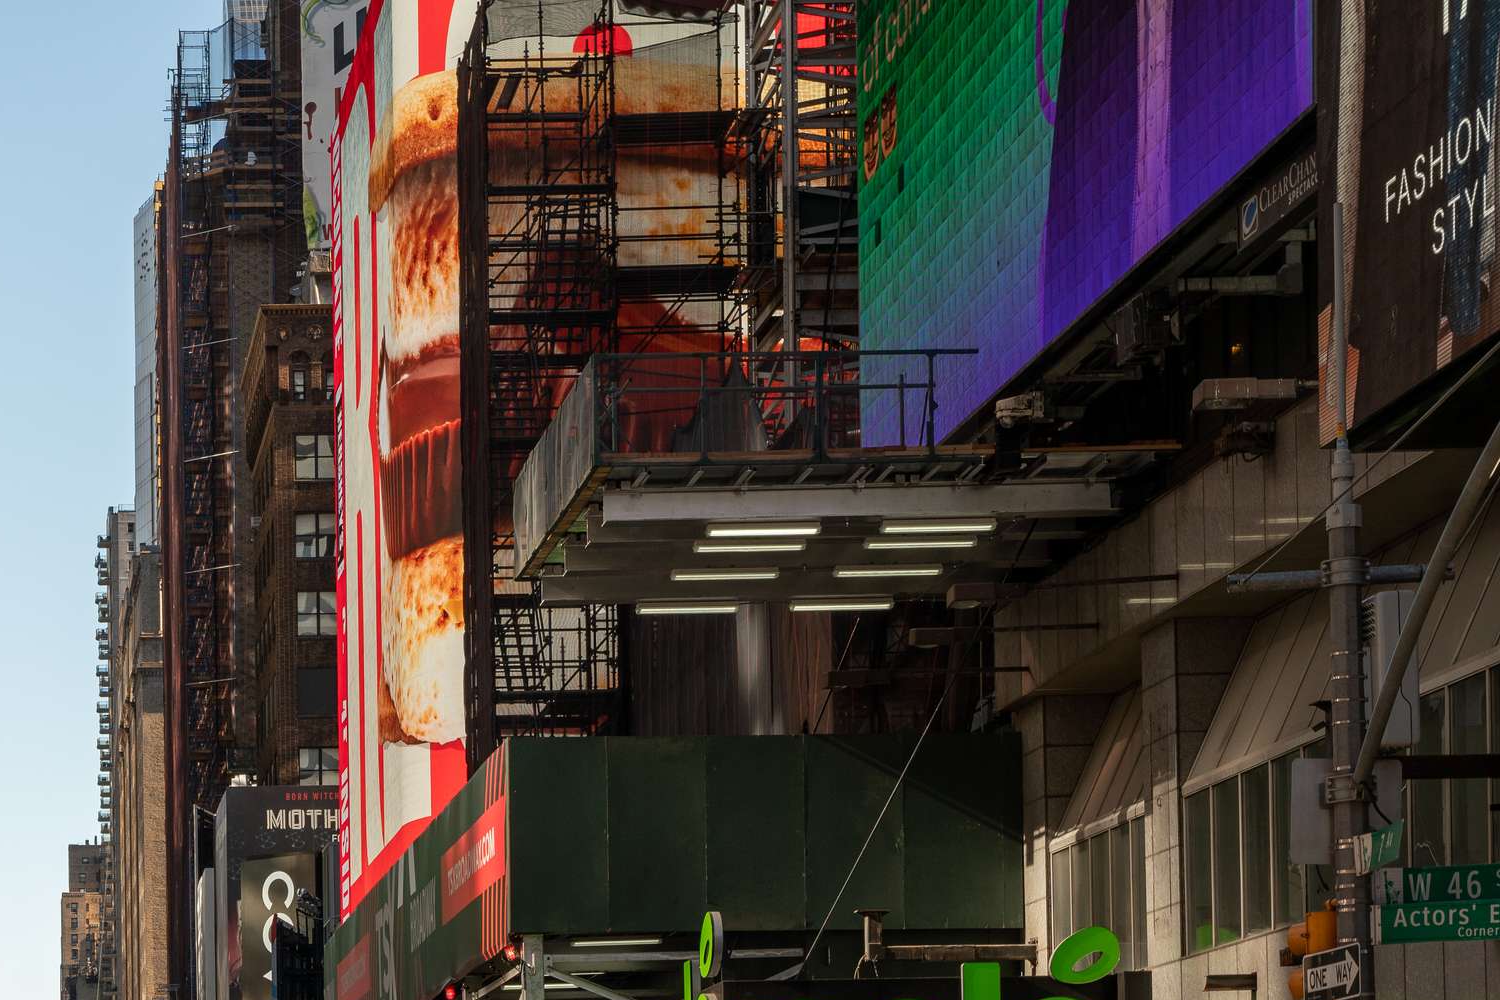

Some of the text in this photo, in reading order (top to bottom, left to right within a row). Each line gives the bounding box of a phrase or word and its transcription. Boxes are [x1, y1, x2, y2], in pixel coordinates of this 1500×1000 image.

[1384, 98, 1492, 224] FASHION
[1432, 173, 1496, 255] STYL
[285, 791, 308, 800] BORN
[266, 808, 339, 830] MOTH
[340, 768, 350, 924] INSID
[1408, 870, 1482, 901] W 46
[1392, 904, 1477, 928] Actors'
[1310, 961, 1353, 989] ONE WAY
